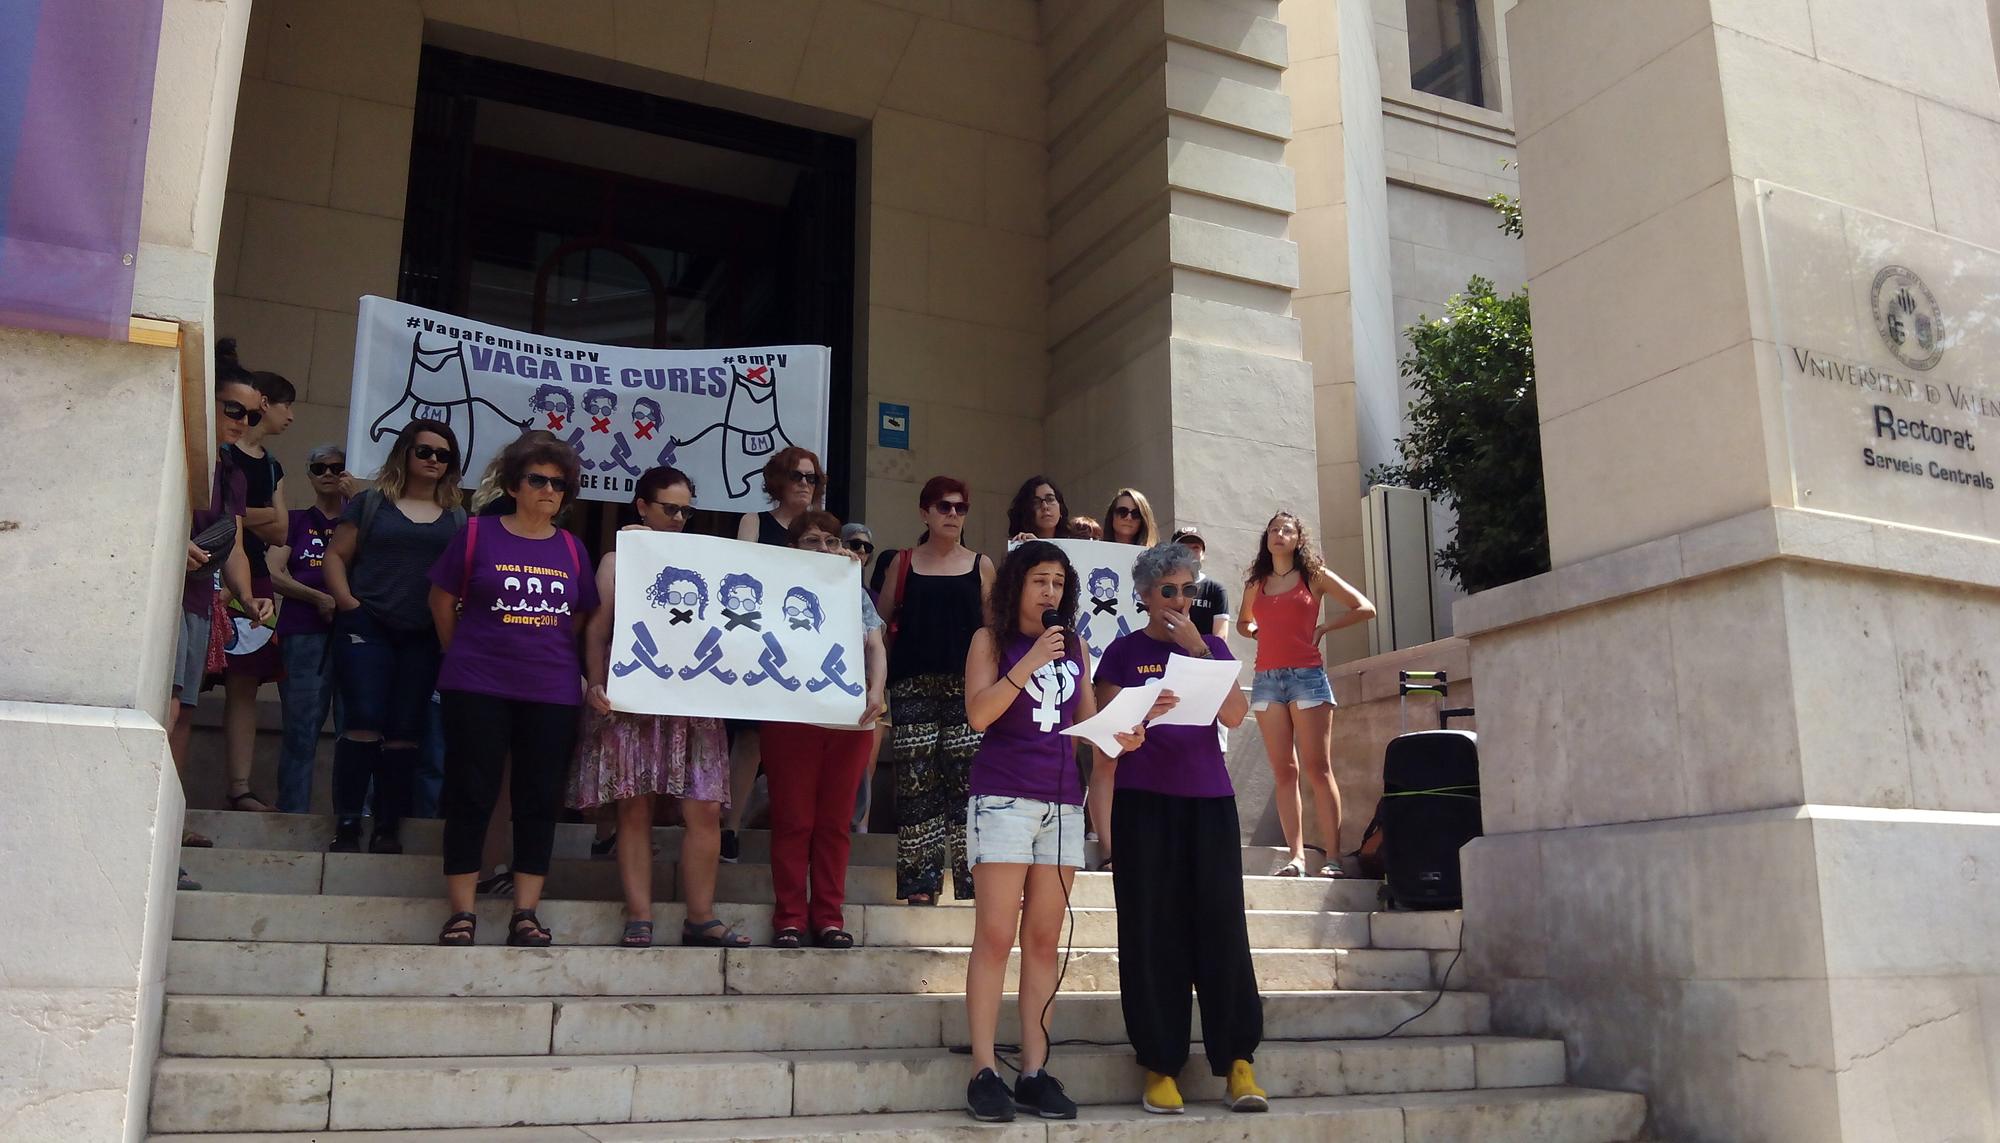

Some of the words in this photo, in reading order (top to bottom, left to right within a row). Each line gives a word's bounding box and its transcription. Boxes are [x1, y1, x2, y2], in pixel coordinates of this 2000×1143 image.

[406, 316, 599, 363] #VagaFeministaPV
[722, 354, 787, 368] #8mPV
[469, 345, 563, 382] VAGA
[570, 362, 613, 386] DE
[620, 366, 727, 398] CURES
[420, 405, 442, 421] 8M
[1873, 404, 1976, 451] Rectorat
[750, 436, 768, 451] 8M
[1863, 447, 1923, 477] Serveis
[1928, 461, 1995, 490] Centrals
[604, 476, 618, 491] EL
[495, 564, 521, 573] VAGA
[523, 565, 569, 579] FEMINISTA
[502, 613, 558, 627] 8març2018
[1136, 663, 1163, 674] VAGA
